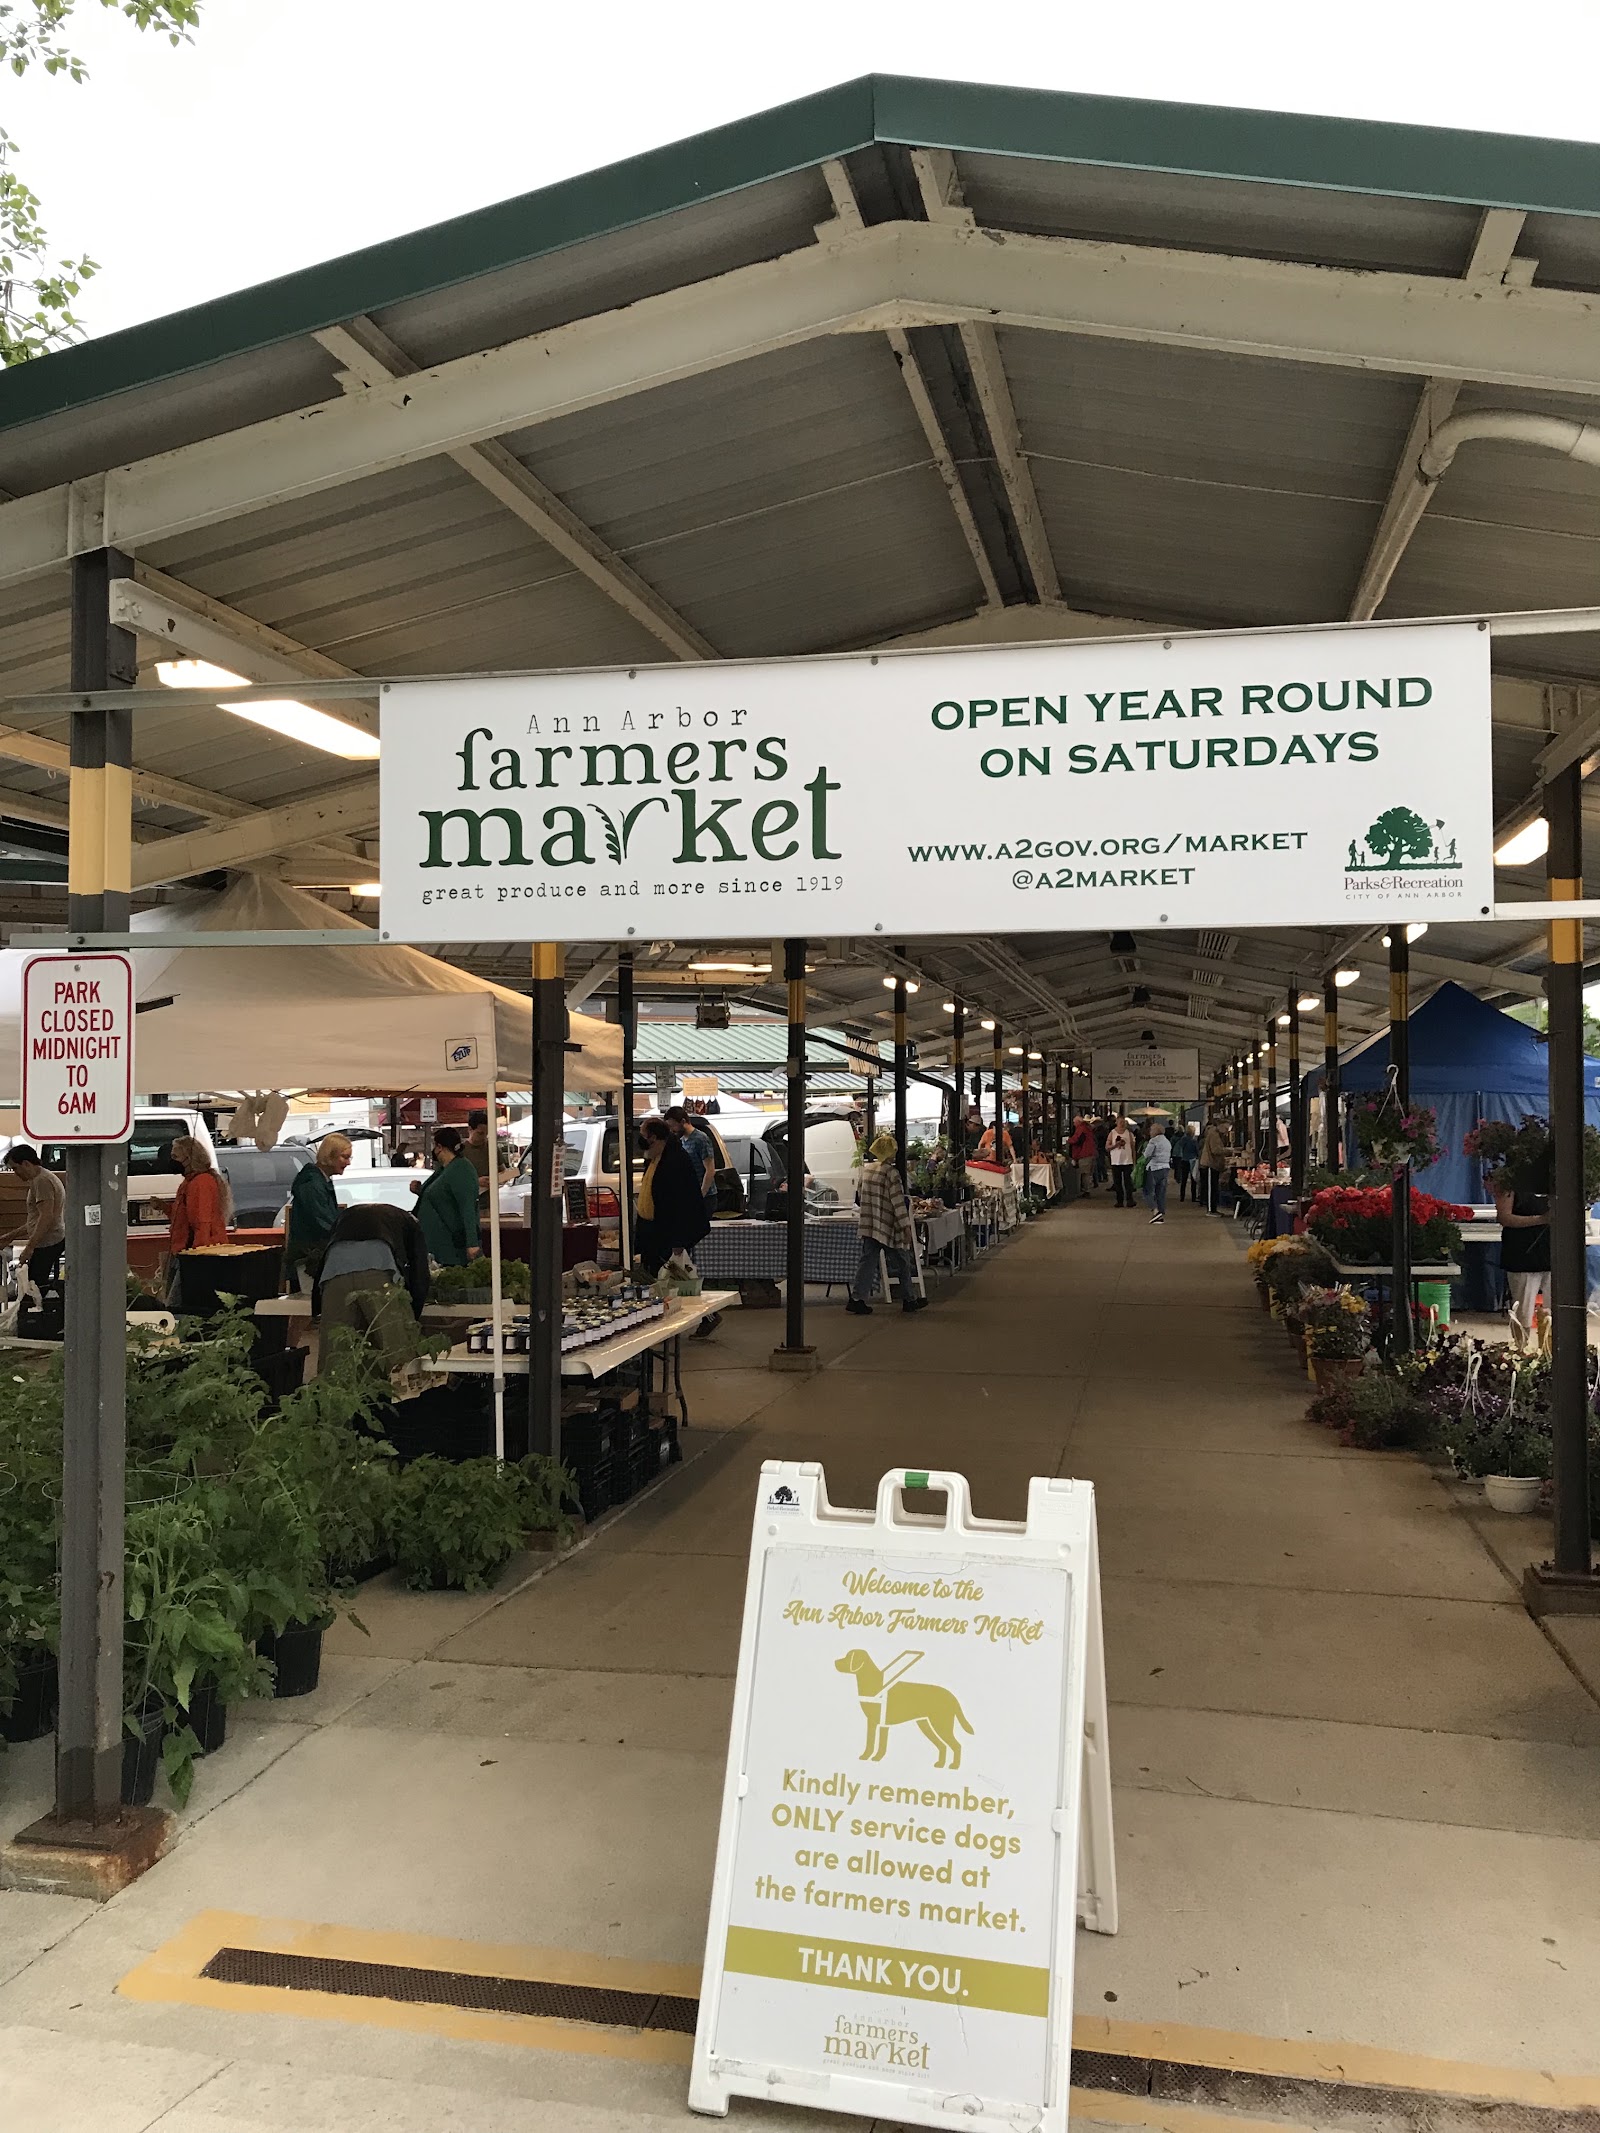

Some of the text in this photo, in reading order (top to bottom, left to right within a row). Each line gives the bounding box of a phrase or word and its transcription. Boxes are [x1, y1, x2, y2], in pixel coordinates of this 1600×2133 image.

[527, 707, 747, 734] Ann Arbor
[932, 678, 1432, 730] OPEN YEAR ROUND
[456, 726, 787, 792] farmers
[981, 732, 1378, 778] ON SATURDAYS
[419, 764, 842, 868] market
[907, 832, 1307, 862] WWW.A2GOV.ORG/MARKET
[423, 876, 842, 904] great produce and more since 1919
[1013, 868, 1195, 889] @A2MARKET
[55, 981, 100, 1004] PARK
[42, 1009, 113, 1032] CLOSED
[33, 1037, 121, 1060] MIDNIGHT
[1123, 1057, 1166, 1066] market
[66, 1065, 88, 1087] TO
[58, 1092, 95, 1114] 6AM
[842, 1567, 984, 1601] Welcome to the
[783, 1600, 1044, 1645] Ann Arbor Farmers Market
[782, 1768, 1014, 1820] Kindly remember,
[772, 1804, 1020, 1859] ONLY service dogs
[795, 1850, 990, 1888] are allowed at
[756, 1875, 1025, 1932] the farmers market.
[798, 1947, 968, 1996] THANK YOU.
[835, 2015, 918, 2045] farmers
[823, 2035, 930, 2070] market
